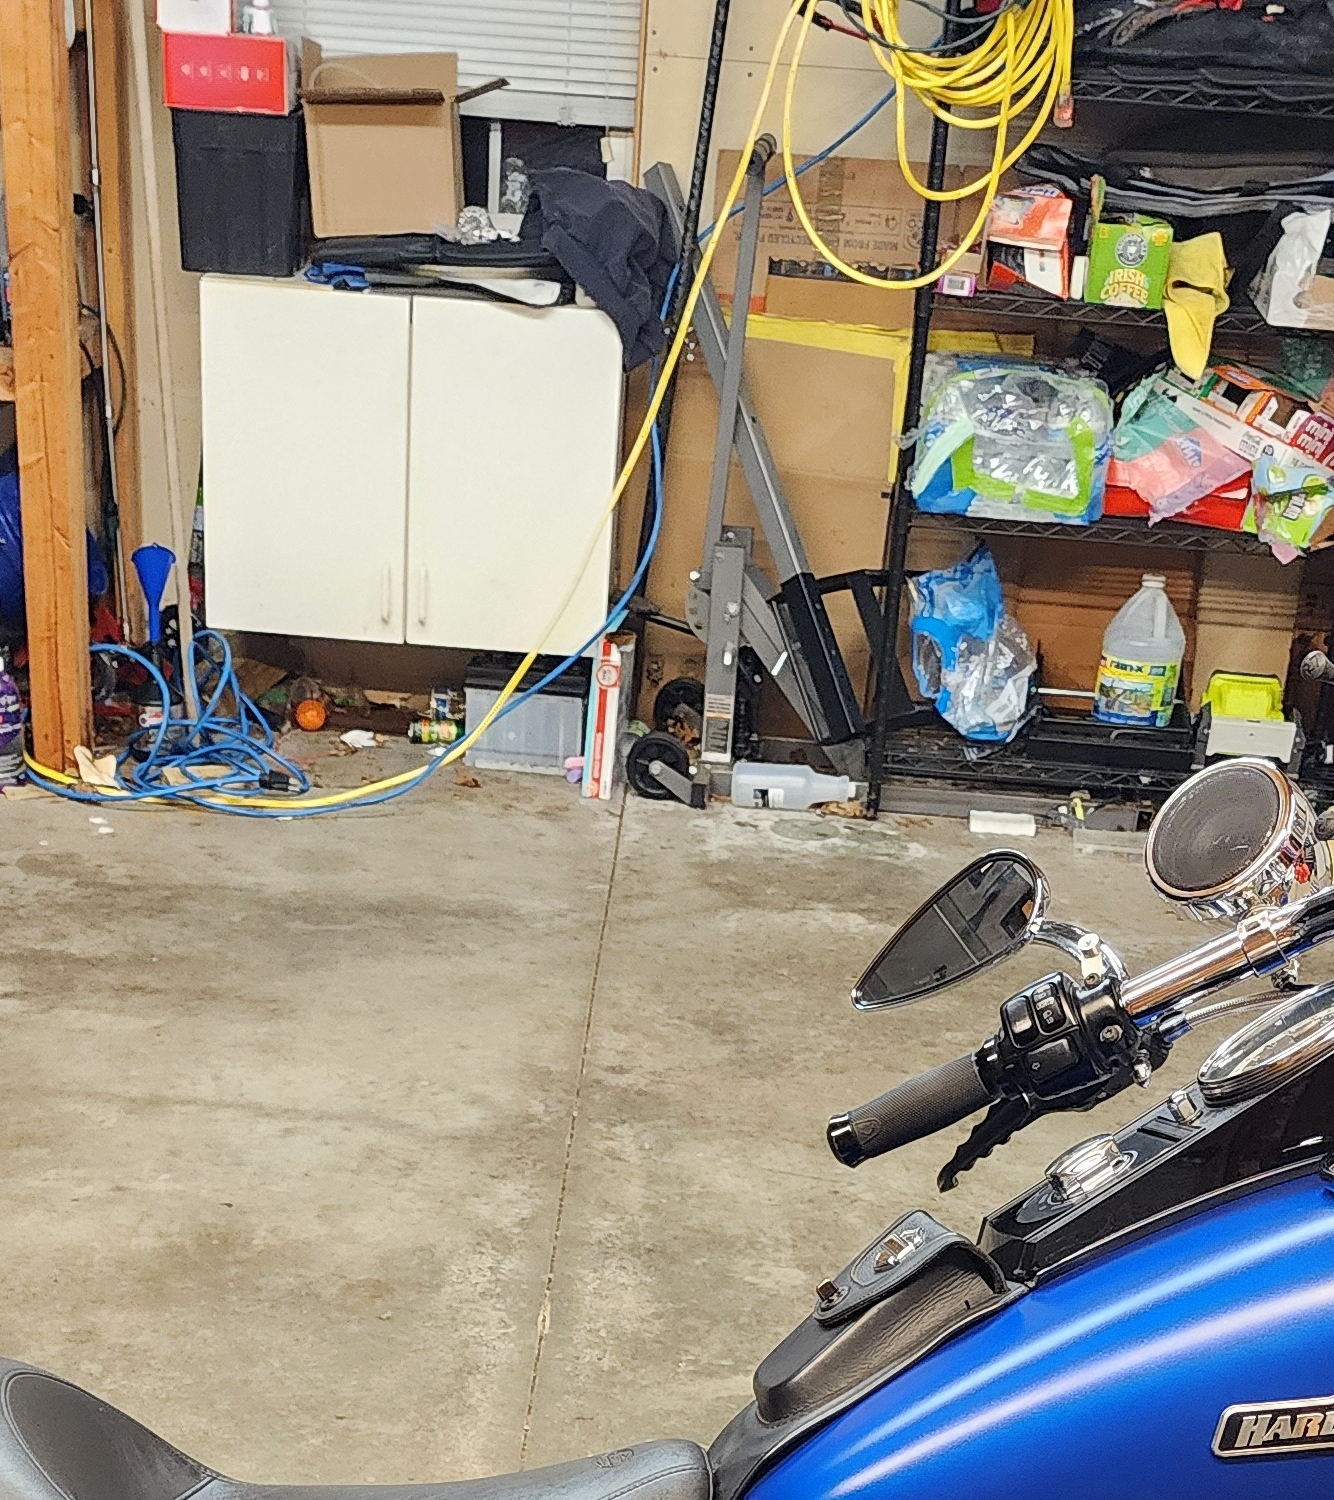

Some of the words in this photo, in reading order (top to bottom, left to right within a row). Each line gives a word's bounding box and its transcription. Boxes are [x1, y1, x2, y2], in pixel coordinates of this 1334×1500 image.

[1109, 268, 1147, 285] IRISH
[1100, 282, 1149, 305] COFFEE
[1296, 433, 1326, 460] mini
